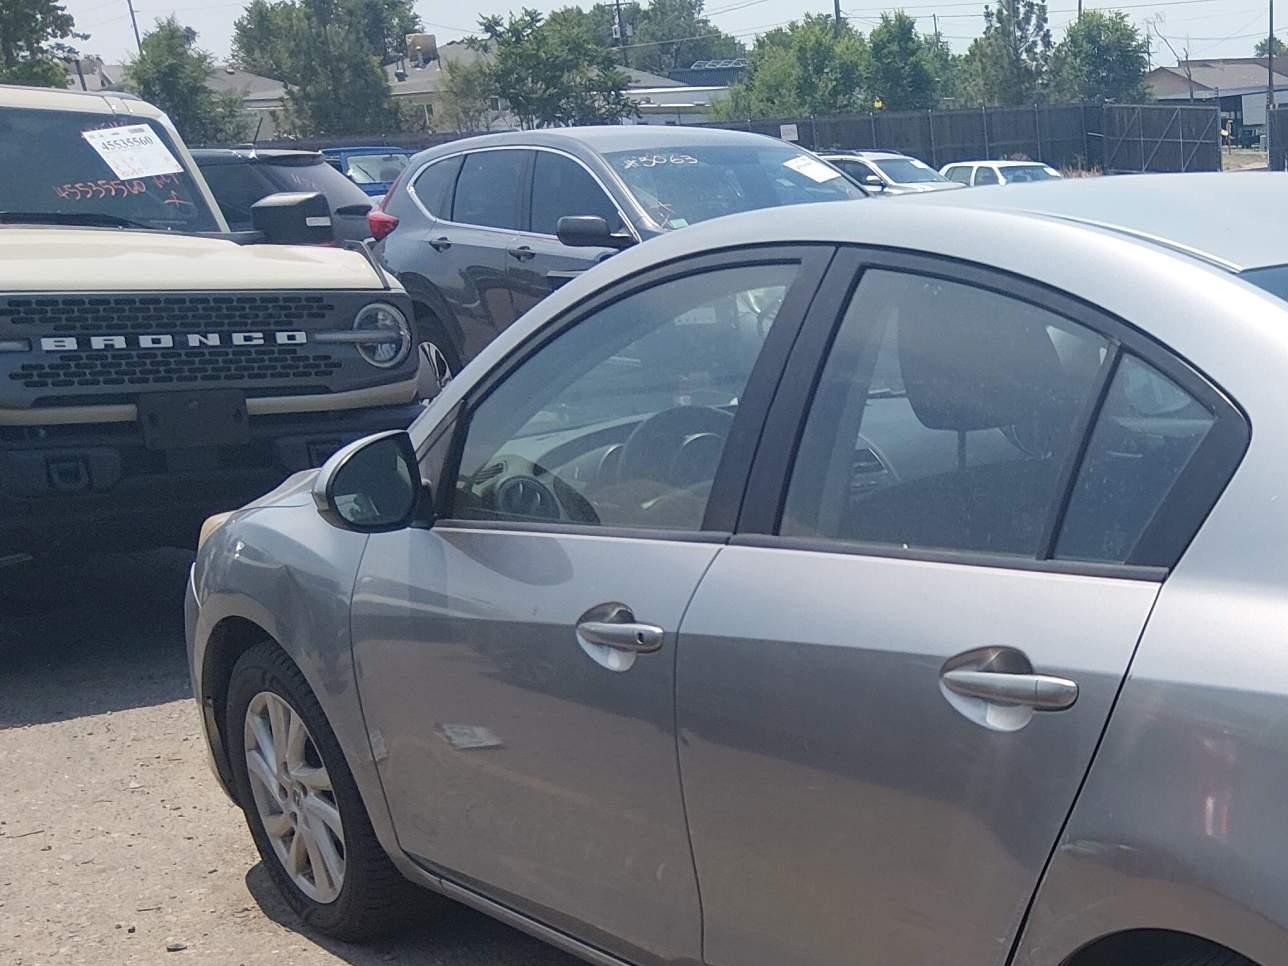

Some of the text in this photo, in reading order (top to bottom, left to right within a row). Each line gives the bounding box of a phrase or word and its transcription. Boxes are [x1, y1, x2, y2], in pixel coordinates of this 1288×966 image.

[101, 135, 155, 151] 45535560
[53, 179, 147, 200] 45535560
[40, 331, 307, 351] BRONCO
